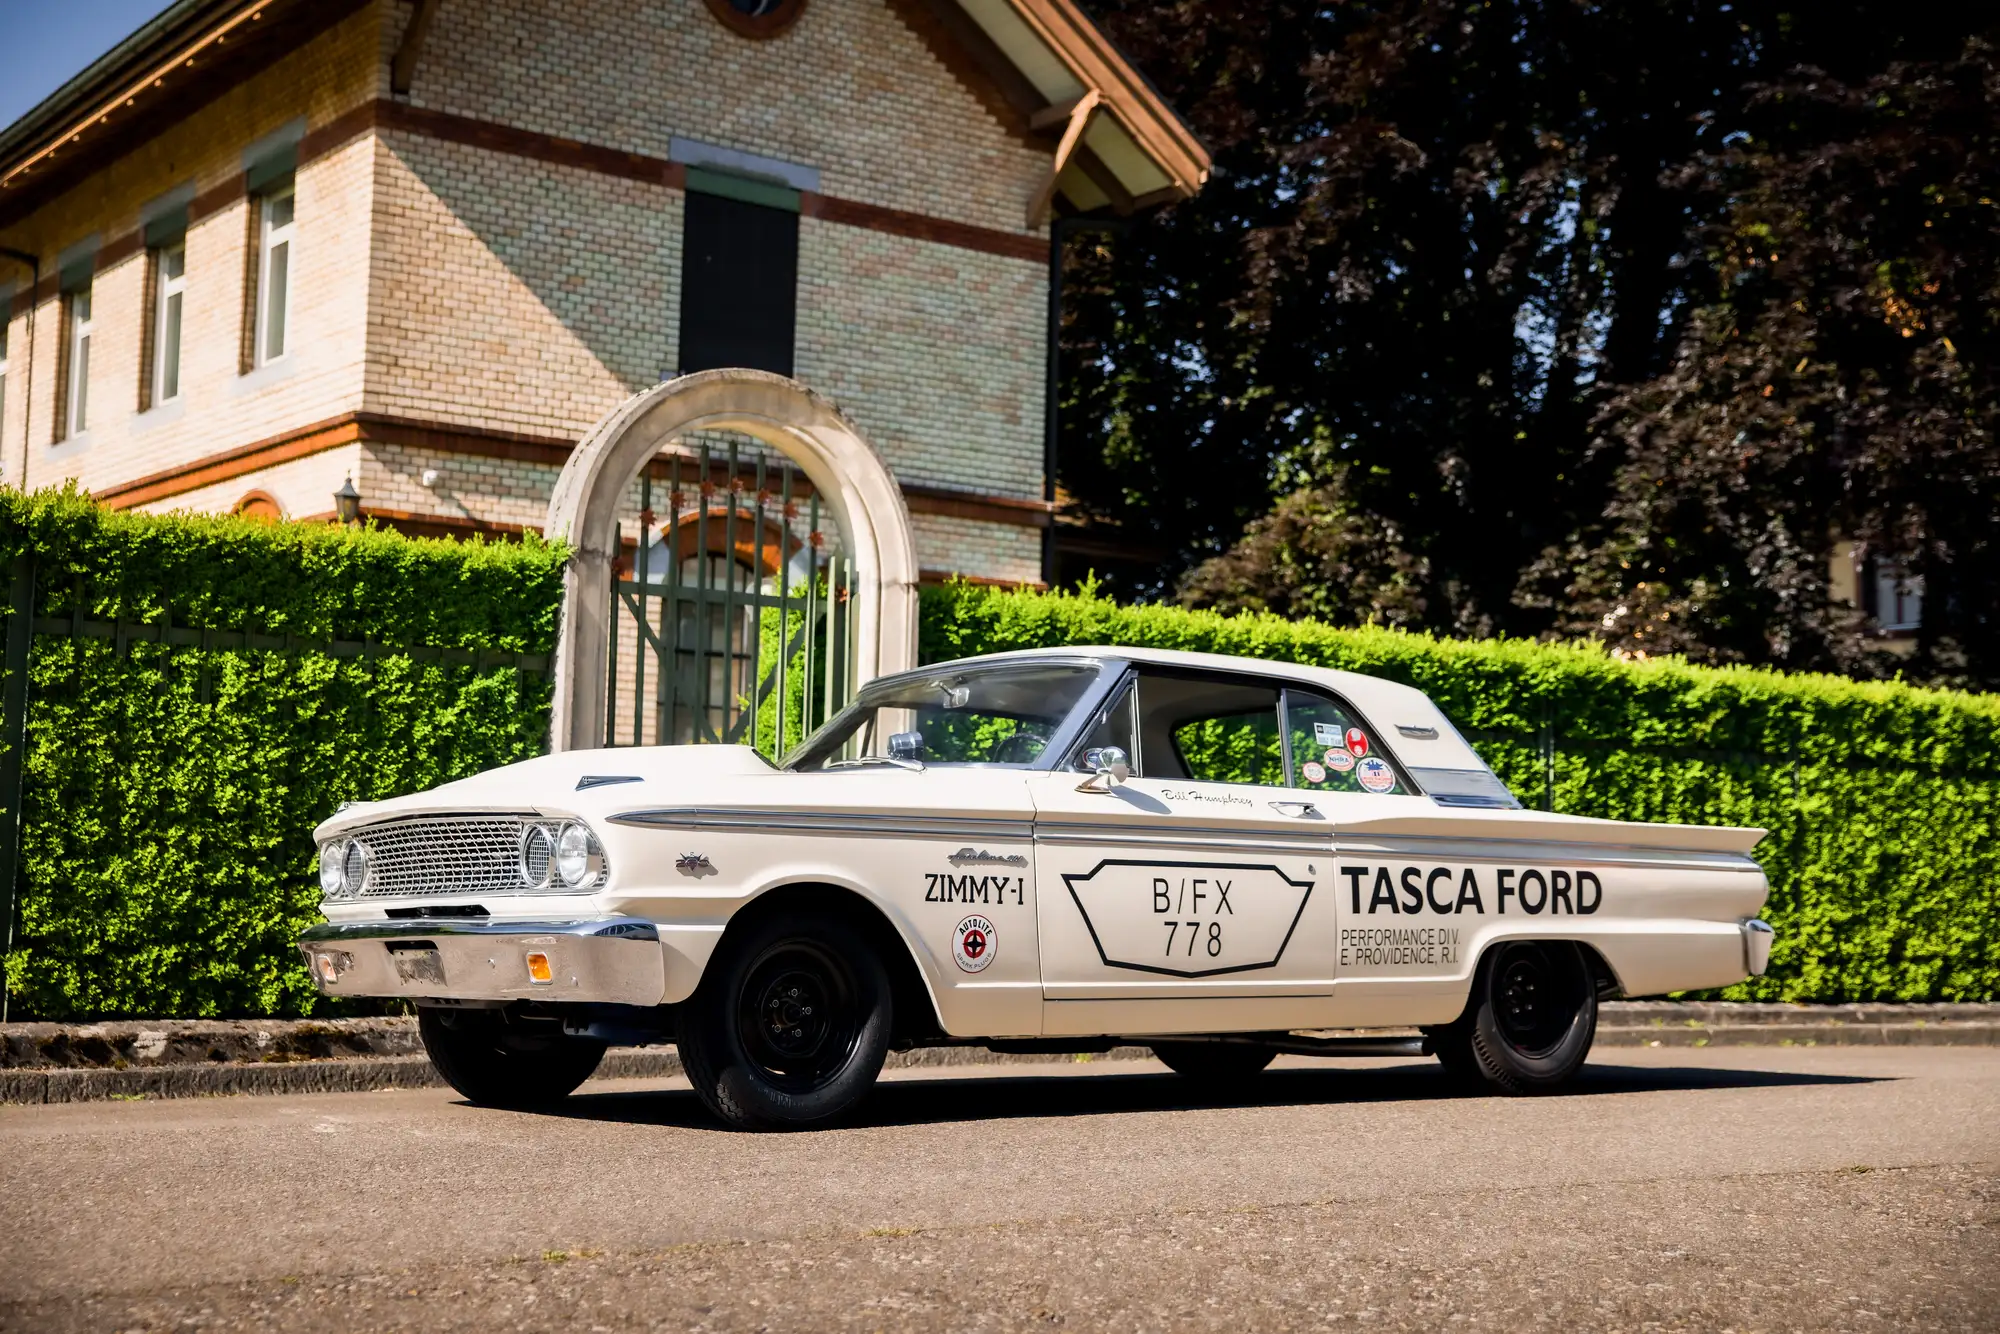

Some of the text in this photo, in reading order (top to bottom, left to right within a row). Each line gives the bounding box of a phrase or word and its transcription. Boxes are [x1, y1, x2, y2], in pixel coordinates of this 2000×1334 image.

[1161, 789, 1253, 807] Bill Humphrey
[925, 873, 1024, 905] ZIMMY-I
[1153, 878, 1233, 915] B/FX
[1341, 867, 1602, 915] TASCA FORD
[958, 919, 993, 937] AUTOLITE
[1341, 928, 1461, 946] PERFORMANCE DIV.
[1164, 921, 1222, 957] 778
[956, 952, 992, 969] SPARK PLUGS
[1340, 946, 1459, 966] E. PROVIDENCE, R.I.
